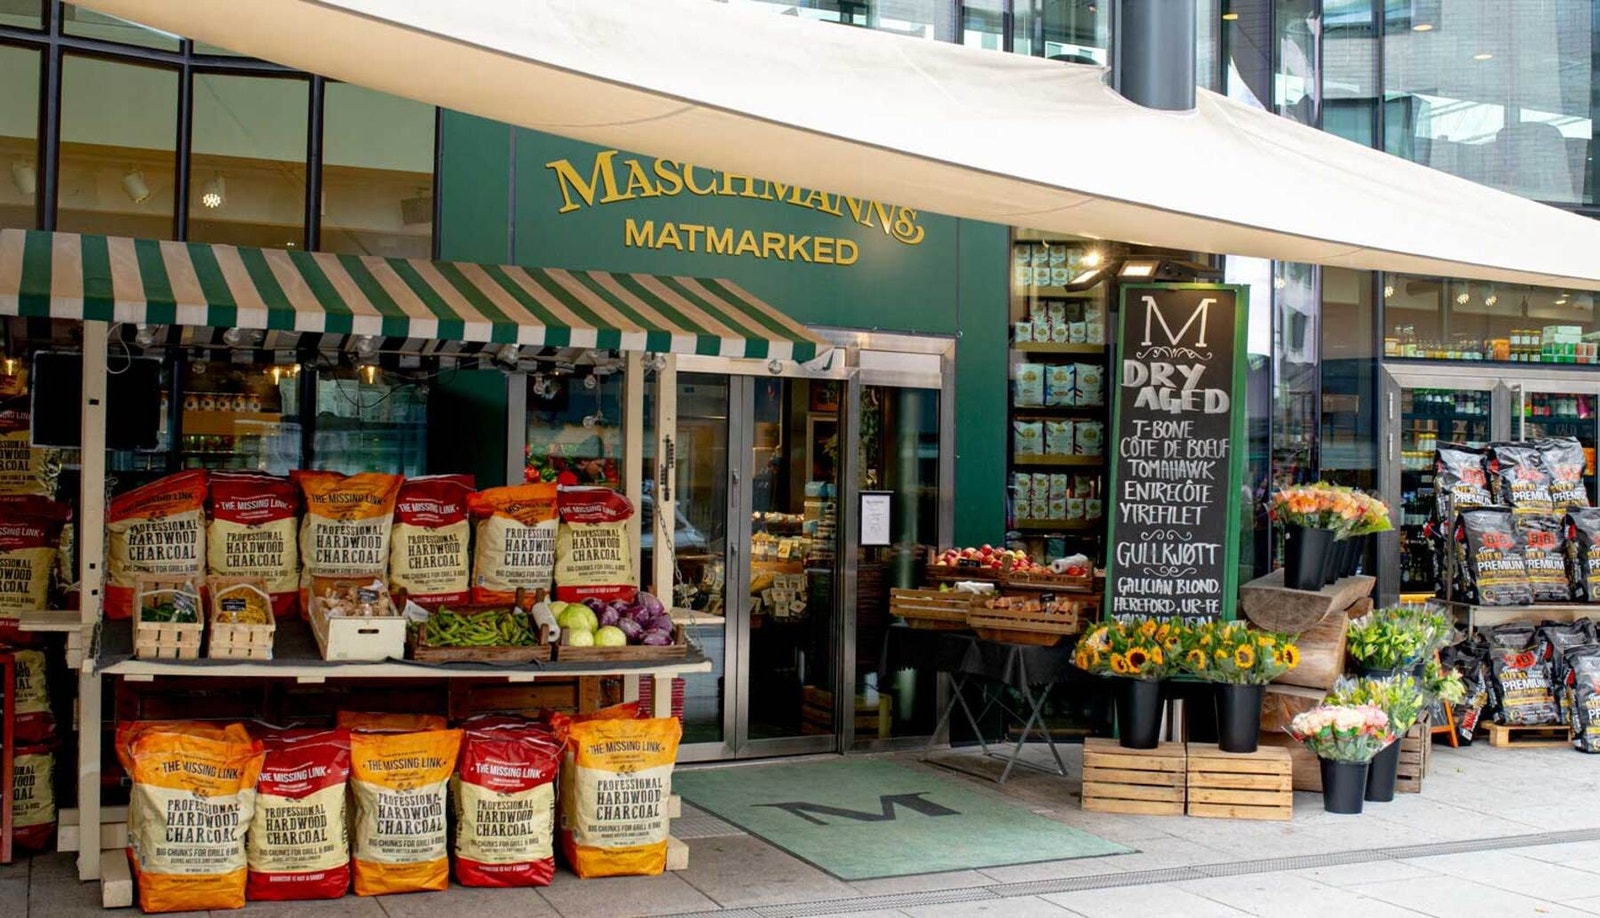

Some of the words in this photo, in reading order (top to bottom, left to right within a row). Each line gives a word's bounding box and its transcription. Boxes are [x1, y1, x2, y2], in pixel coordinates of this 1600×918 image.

[624, 218, 859, 265] MATMARKED
[1141, 295, 1217, 347] M
[1121, 359, 1206, 391] DRY
[1134, 386, 1230, 414] AGED
[1132, 420, 1194, 439] T-BONE
[1164, 440, 1182, 459] DE
[1187, 438, 1230, 458] BOEUF
[1127, 459, 1216, 480] TOMAHAWK
[1124, 479, 1213, 503] ENTRECÔTE
[221, 501, 235, 511] THE
[237, 499, 269, 510] MISSING
[270, 499, 288, 509] LINK
[312, 494, 327, 504] THE
[329, 494, 364, 504] MISSING
[398, 504, 409, 512] THE
[412, 503, 438, 513] MISSING
[439, 504, 456, 514] LINK
[559, 507, 571, 515] THE
[573, 506, 601, 514] MISSING
[1120, 502, 1208, 525] YTREFILET
[129, 520, 198, 533] PROFESSIONAL
[317, 524, 383, 536] PROFESSIONAL
[572, 529, 620, 538] PROFESSIONAL
[129, 531, 197, 546] HARDWOOD
[227, 532, 283, 542] PROFESSIONAL
[316, 536, 382, 549] HARDWOOD
[408, 534, 459, 543] PROFESSIONAL
[572, 538, 620, 549] HARDWOOD
[129, 545, 197, 561] CHARCOAL
[226, 541, 283, 554] HARDWOOD
[408, 543, 460, 556] HARDWOOD
[226, 554, 283, 568] CHARCOAL
[316, 550, 381, 564] CHARCOAL
[409, 555, 461, 569] CHARCOAL
[504, 553, 555, 566] CHARCOA
[573, 549, 621, 562] CHARCOAL
[1117, 542, 1222, 568] GULLKJØTT
[1478, 559, 1525, 572] PREMIUM
[1118, 577, 1172, 595] GALICIAN
[590, 743, 603, 755] THE
[606, 741, 640, 753] MISSING
[642, 741, 661, 753] LINK
[163, 760, 180, 773] THE
[182, 762, 216, 777] MISSING
[217, 767, 238, 780] LINK
[368, 760, 382, 771] THE
[383, 757, 419, 771] MISSING
[421, 757, 442, 769] LINK
[476, 763, 489, 774] THE
[490, 765, 521, 777] MISSING
[522, 768, 542, 779] LINK
[273, 770, 308, 783] MISSING
[309, 766, 327, 778] LINK
[598, 778, 662, 791] PROFESSIONAL
[477, 799, 533, 809] PROFESSIONAL
[597, 790, 661, 805] HARDWOOD
[167, 799, 240, 815] PROFESSIONAL
[265, 804, 326, 818] PROFESSIONAL
[378, 802, 442, 820] HARDWOOD
[596, 804, 660, 820] CHARCOAL
[166, 812, 239, 828] HARDWOOD
[266, 815, 327, 831] HARDWOOD
[476, 810, 533, 823] HARDWOOD
[377, 817, 443, 835] CHARCOAL
[476, 823, 533, 837] CHARCOAL
[166, 828, 238, 843] CHARCOAL
[267, 829, 328, 845] CHARCOAL
